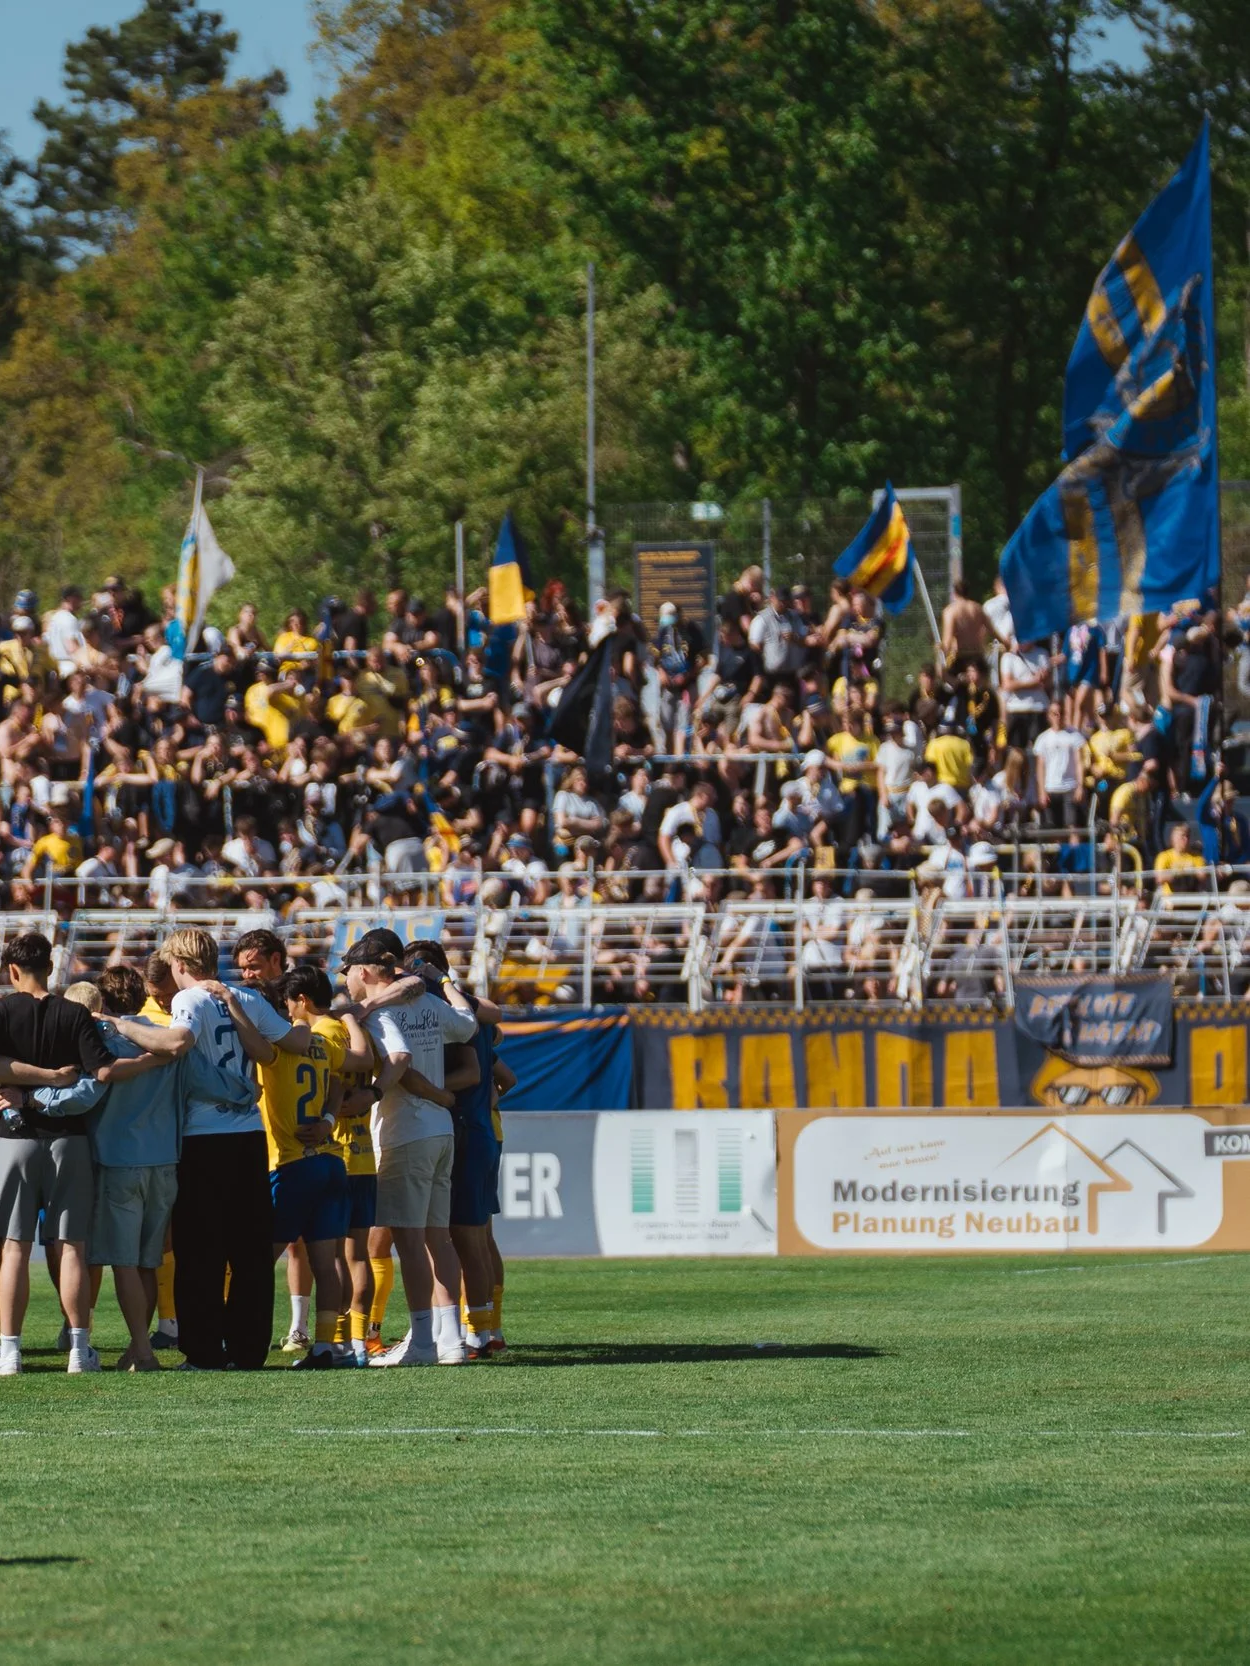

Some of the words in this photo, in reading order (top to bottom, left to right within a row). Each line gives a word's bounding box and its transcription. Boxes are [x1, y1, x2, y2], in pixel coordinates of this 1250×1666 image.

[832, 1179, 1081, 1206] Modernisierung
[832, 1211, 956, 1238] Planung
[964, 1211, 1081, 1233] Neubau
